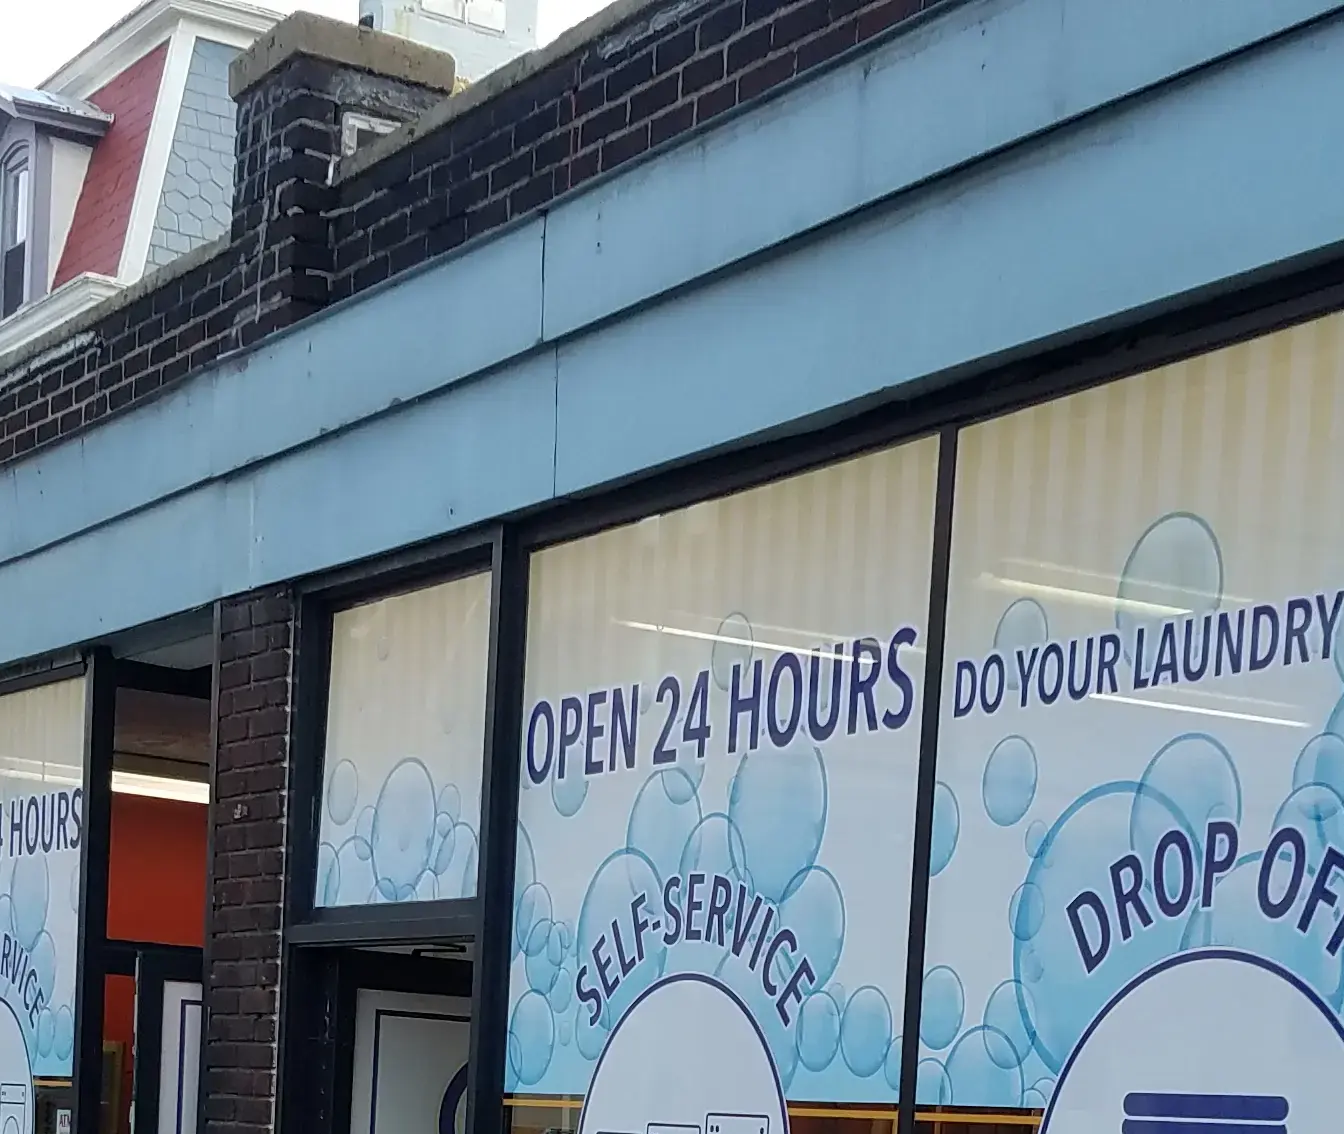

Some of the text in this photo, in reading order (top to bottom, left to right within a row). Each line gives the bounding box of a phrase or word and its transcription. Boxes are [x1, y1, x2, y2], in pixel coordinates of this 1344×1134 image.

[527, 627, 918, 785] OPEN 24 HOURS
[954, 660, 1004, 718] DO
[1017, 634, 1119, 709] YOUR
[1133, 592, 1344, 689] LAUNDRY
[9, 788, 82, 858] HOURS
[1066, 821, 1239, 974] DROP
[576, 874, 816, 1027] SELF-SERVICE
